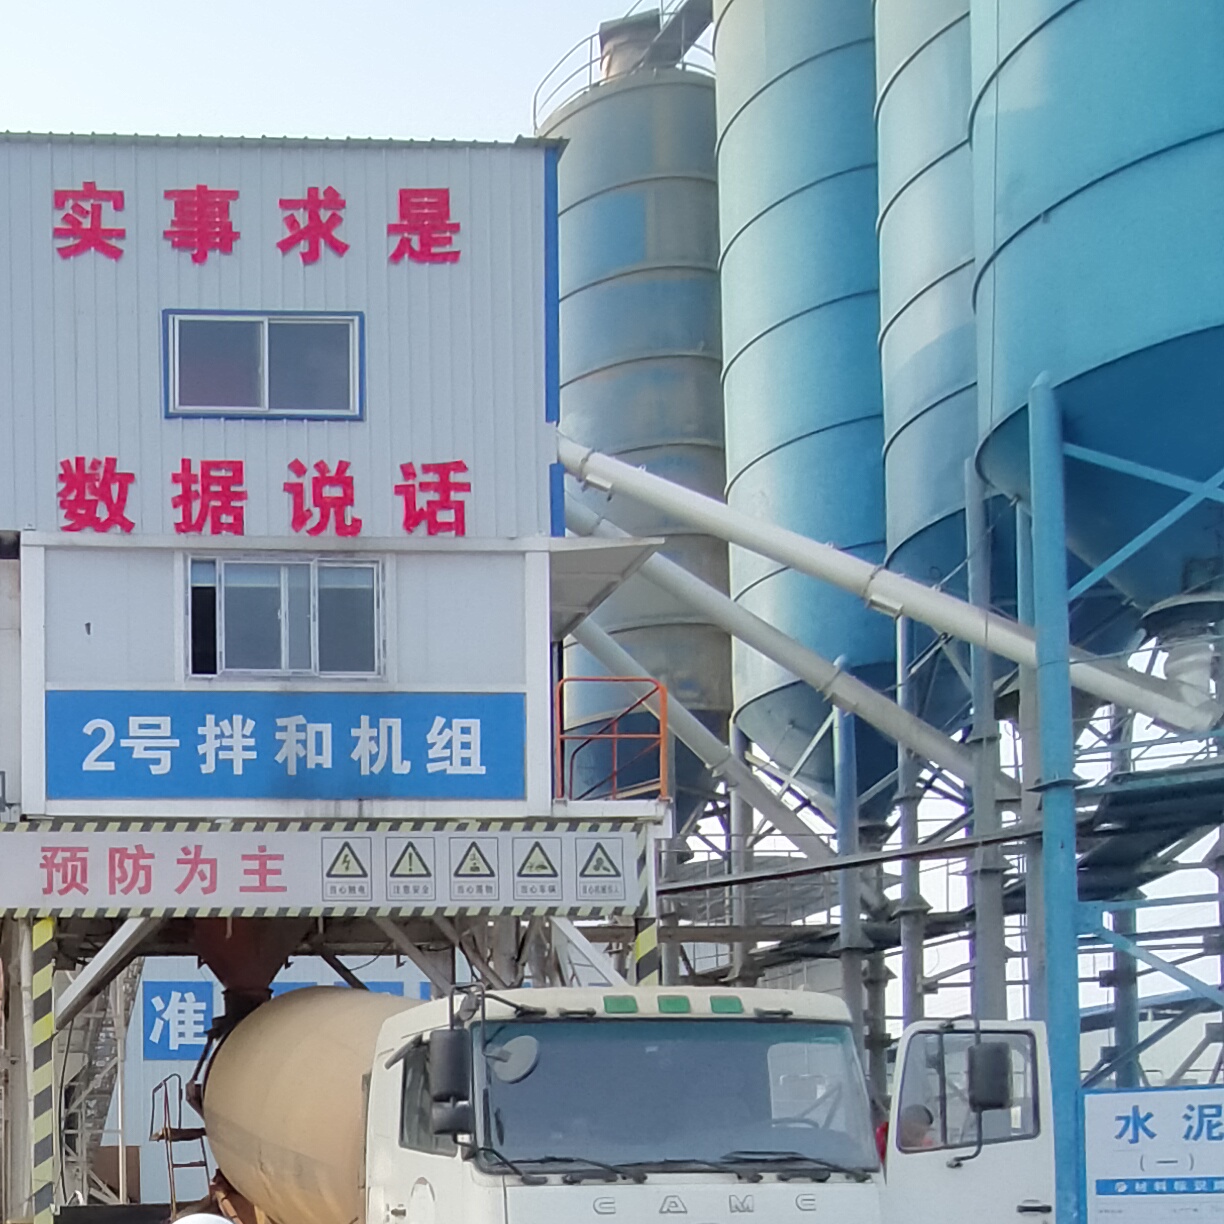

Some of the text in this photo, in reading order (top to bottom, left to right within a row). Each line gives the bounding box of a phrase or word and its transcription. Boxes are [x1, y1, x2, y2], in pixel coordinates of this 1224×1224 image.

[53, 181, 462, 265] 实事求是
[57, 456, 472, 538] 数据说话
[82, 714, 487, 776] 2号拌和机组
[39, 845, 288, 896] 预防为主
[1114, 1104, 1224, 1144] 水泥
